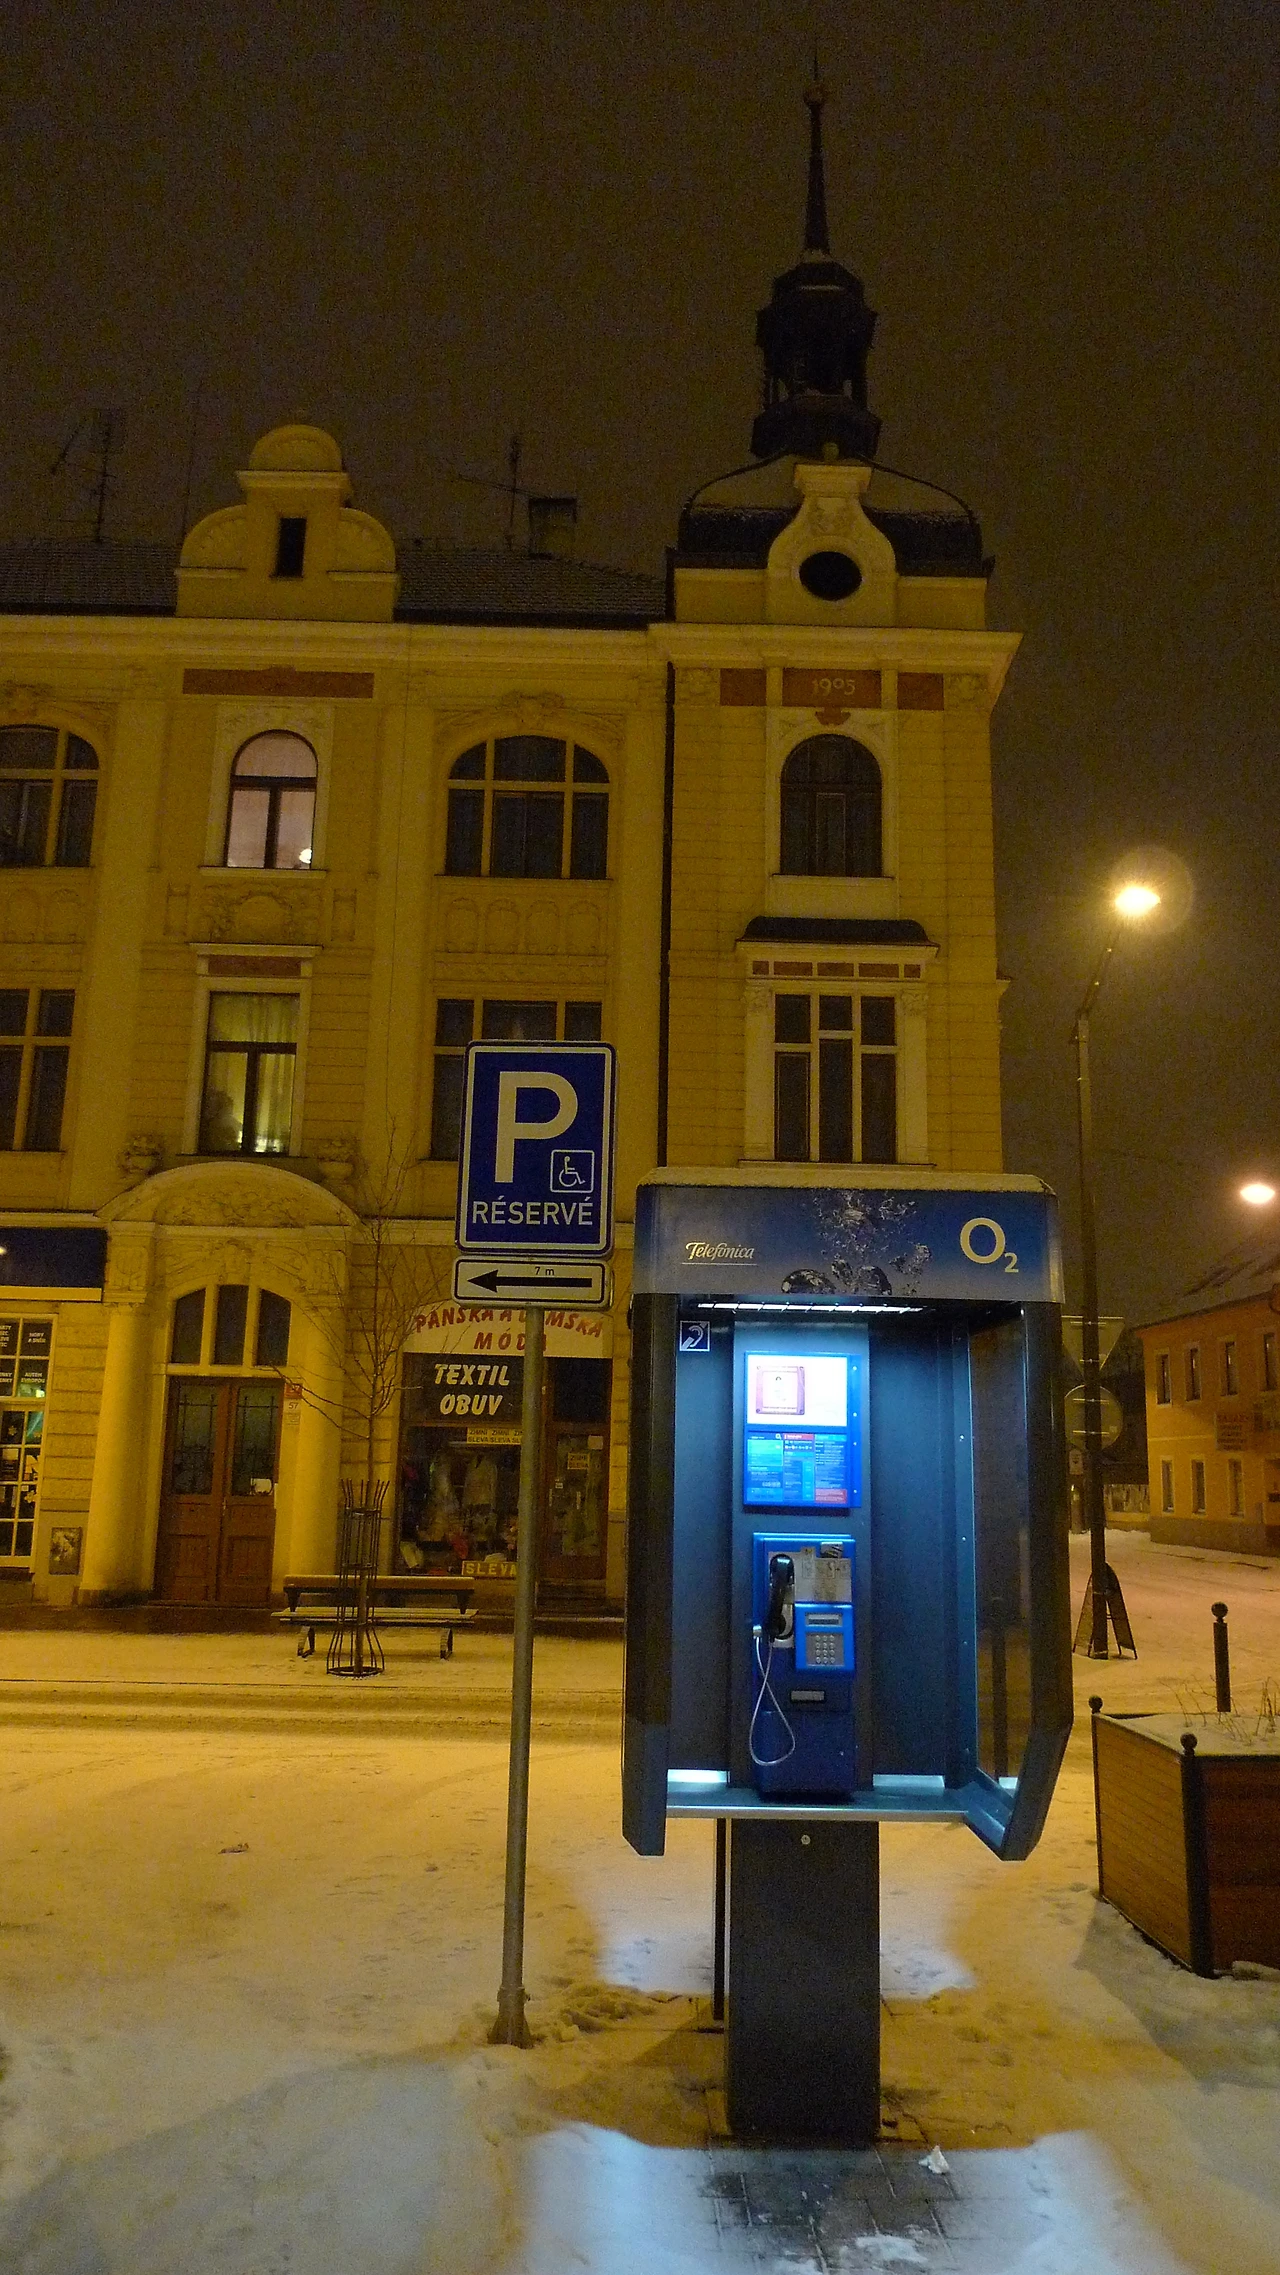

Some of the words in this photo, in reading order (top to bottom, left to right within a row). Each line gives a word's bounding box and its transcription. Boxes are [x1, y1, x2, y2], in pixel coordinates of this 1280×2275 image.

[812, 678, 856, 696] 1905
[494, 1071, 579, 1184] P
[472, 1195, 594, 1226] RÉSERVÉ
[534, 1266, 541, 1276] 7
[545, 1268, 555, 1276] m
[434, 1363, 510, 1386] TEXTIL
[288, 1402, 299, 1410] 57
[439, 1393, 504, 1416] OBUV
[465, 1562, 518, 1577] SLEVA
